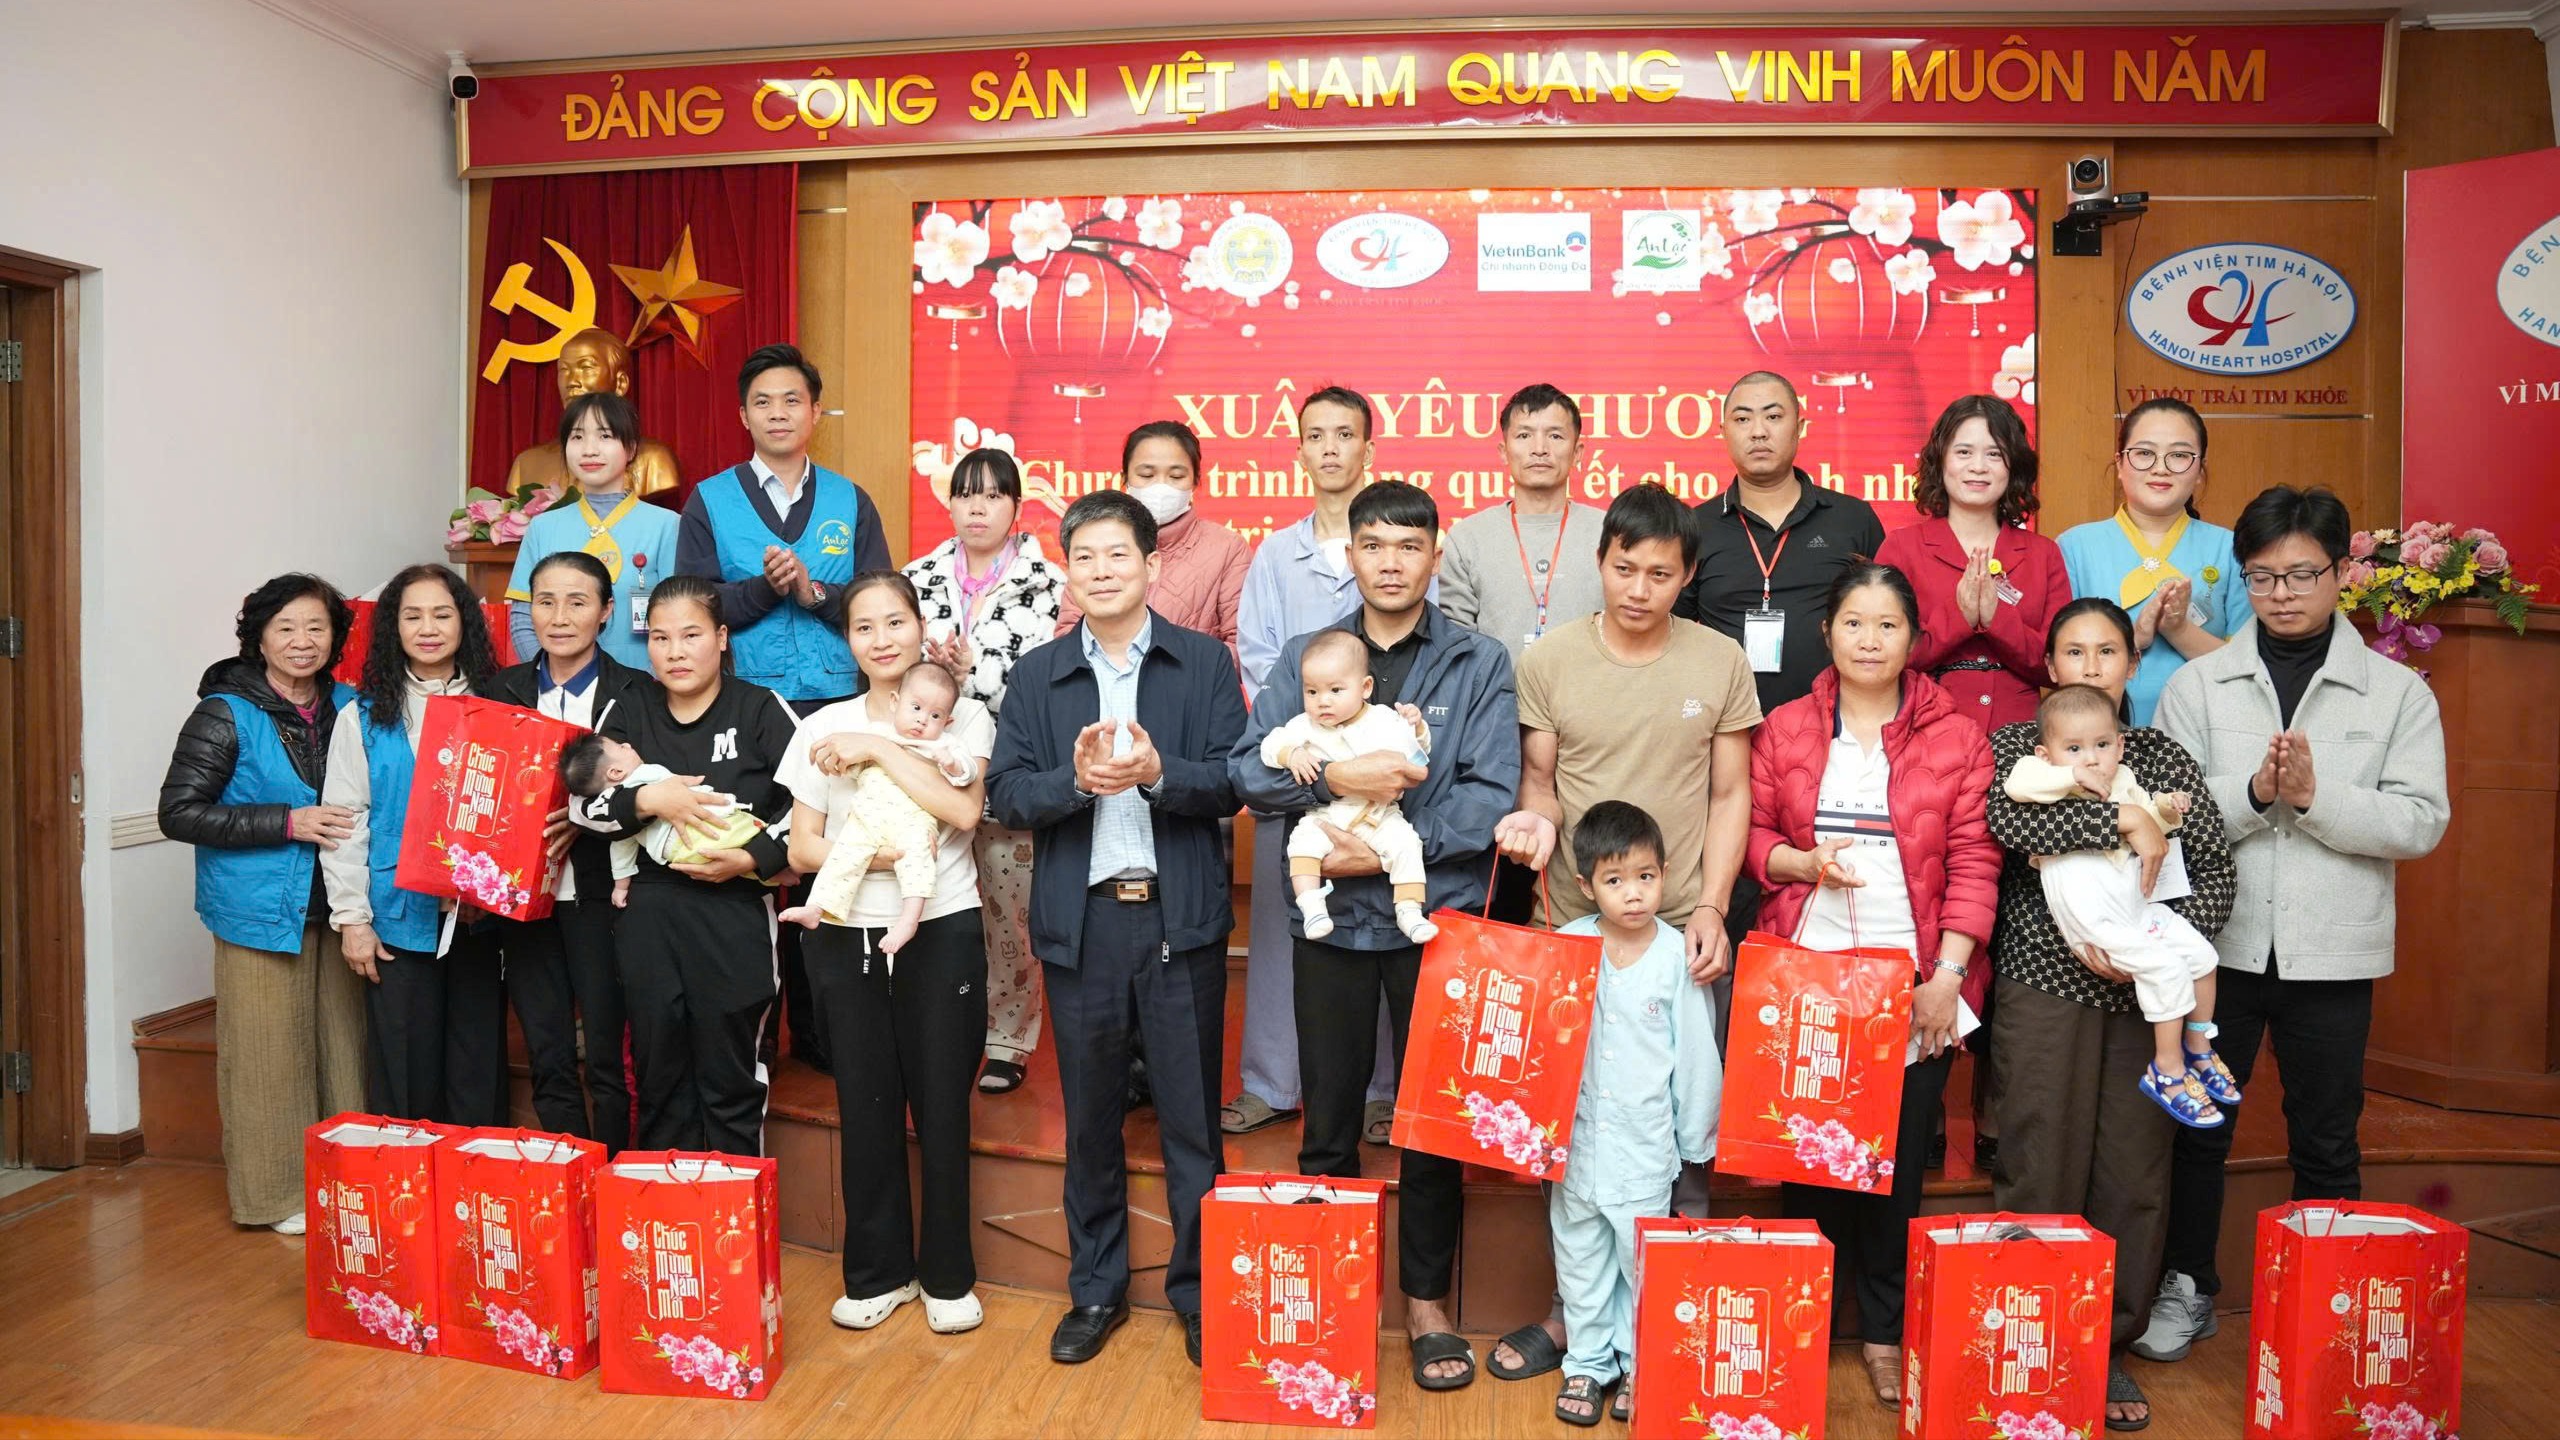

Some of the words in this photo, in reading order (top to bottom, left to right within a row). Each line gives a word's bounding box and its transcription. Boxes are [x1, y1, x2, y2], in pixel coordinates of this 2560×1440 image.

[561, 74, 725, 142] ĐẢNG
[752, 66, 939, 140] CỘNG
[969, 52, 1089, 122] SẢN
[1119, 50, 1235, 125] VIỆT
[1266, 55, 1416, 111] NAM
[1447, 49, 1684, 106] QUANG
[1715, 49, 1861, 103] VINH
[1892, 34, 2085, 103] MUÔN
[2113, 34, 2266, 103] NĂM
[1482, 244, 1566, 257] VietinBank
[2512, 235, 2560, 278] BỆN
[2141, 264, 2188, 301] BỆNH
[2193, 253, 2238, 272] VIỆN
[2245, 255, 2276, 269] TIM
[2284, 260, 2306, 278] HÀ
[2312, 273, 2343, 301] NỘI
[2518, 307, 2560, 338] HAN
[2148, 329, 2196, 362] HANOI
[2200, 353, 2254, 367] HEART
[2261, 331, 2338, 366] HOSPITAL
[2201, 385, 2246, 404] TRÁI
[2253, 388, 2288, 404] TIM
[2498, 379, 2528, 405] VÌ
[1173, 378, 1300, 439] XUÂ
[1368, 377, 1503, 439] YÊU
[1570, 385, 1812, 440] HƯƠ
[1207, 459, 1315, 498] trình
[1448, 470, 1515, 509] qu
[1566, 449, 1625, 500] ết
[1863, 463, 1917, 502] nh
[467, 742, 496, 773] Chúc
[711, 727, 738, 762] M
[461, 768, 496, 797] Mừng
[454, 802, 479, 833] Mới
[470, 789, 496, 820] Năm
[1820, 799, 1884, 810] TOMM
[1486, 969, 1523, 1005] Chúc
[1479, 1001, 1523, 1036] Mừng
[1800, 993, 1837, 1028] Chúc
[1492, 1030, 1523, 1062] Năm
[1797, 1024, 1838, 1060] Mừng
[1472, 1042, 1501, 1079] Mới
[1810, 1051, 1841, 1082] Năm
[1792, 1065, 1821, 1101] Mới
[337, 1181, 364, 1211] Chúc
[480, 1192, 507, 1223] Chúc
[339, 1208, 370, 1240] Mừng
[483, 1221, 512, 1253] Mừng
[653, 1221, 687, 1250] Chúc
[343, 1245, 366, 1275] Mới
[351, 1232, 377, 1258] Năm
[494, 1246, 518, 1275] Năm
[485, 1258, 506, 1291] Mới
[656, 1250, 693, 1283] Mừng
[669, 1274, 699, 1300] Năm
[1716, 1285, 1755, 1319] Chúc
[2005, 1285, 2041, 1317] Chúc
[2368, 1276, 2402, 1308] Chúc
[657, 1288, 684, 1322] Mới
[1284, 1297, 1315, 1324] Năm
[1270, 1312, 1297, 1347] Mới
[1715, 1318, 1758, 1356] Mừng
[2003, 1317, 2044, 1355] Mừng
[2366, 1308, 2404, 1346] Mừng
[1729, 1344, 1762, 1375] Năm
[2017, 1343, 2047, 1371] Năm
[2379, 1333, 2408, 1363] Năm
[1714, 1361, 1743, 1399] Mới
[2000, 1361, 2029, 1398] Mới
[2364, 1352, 2391, 1390] Mới
